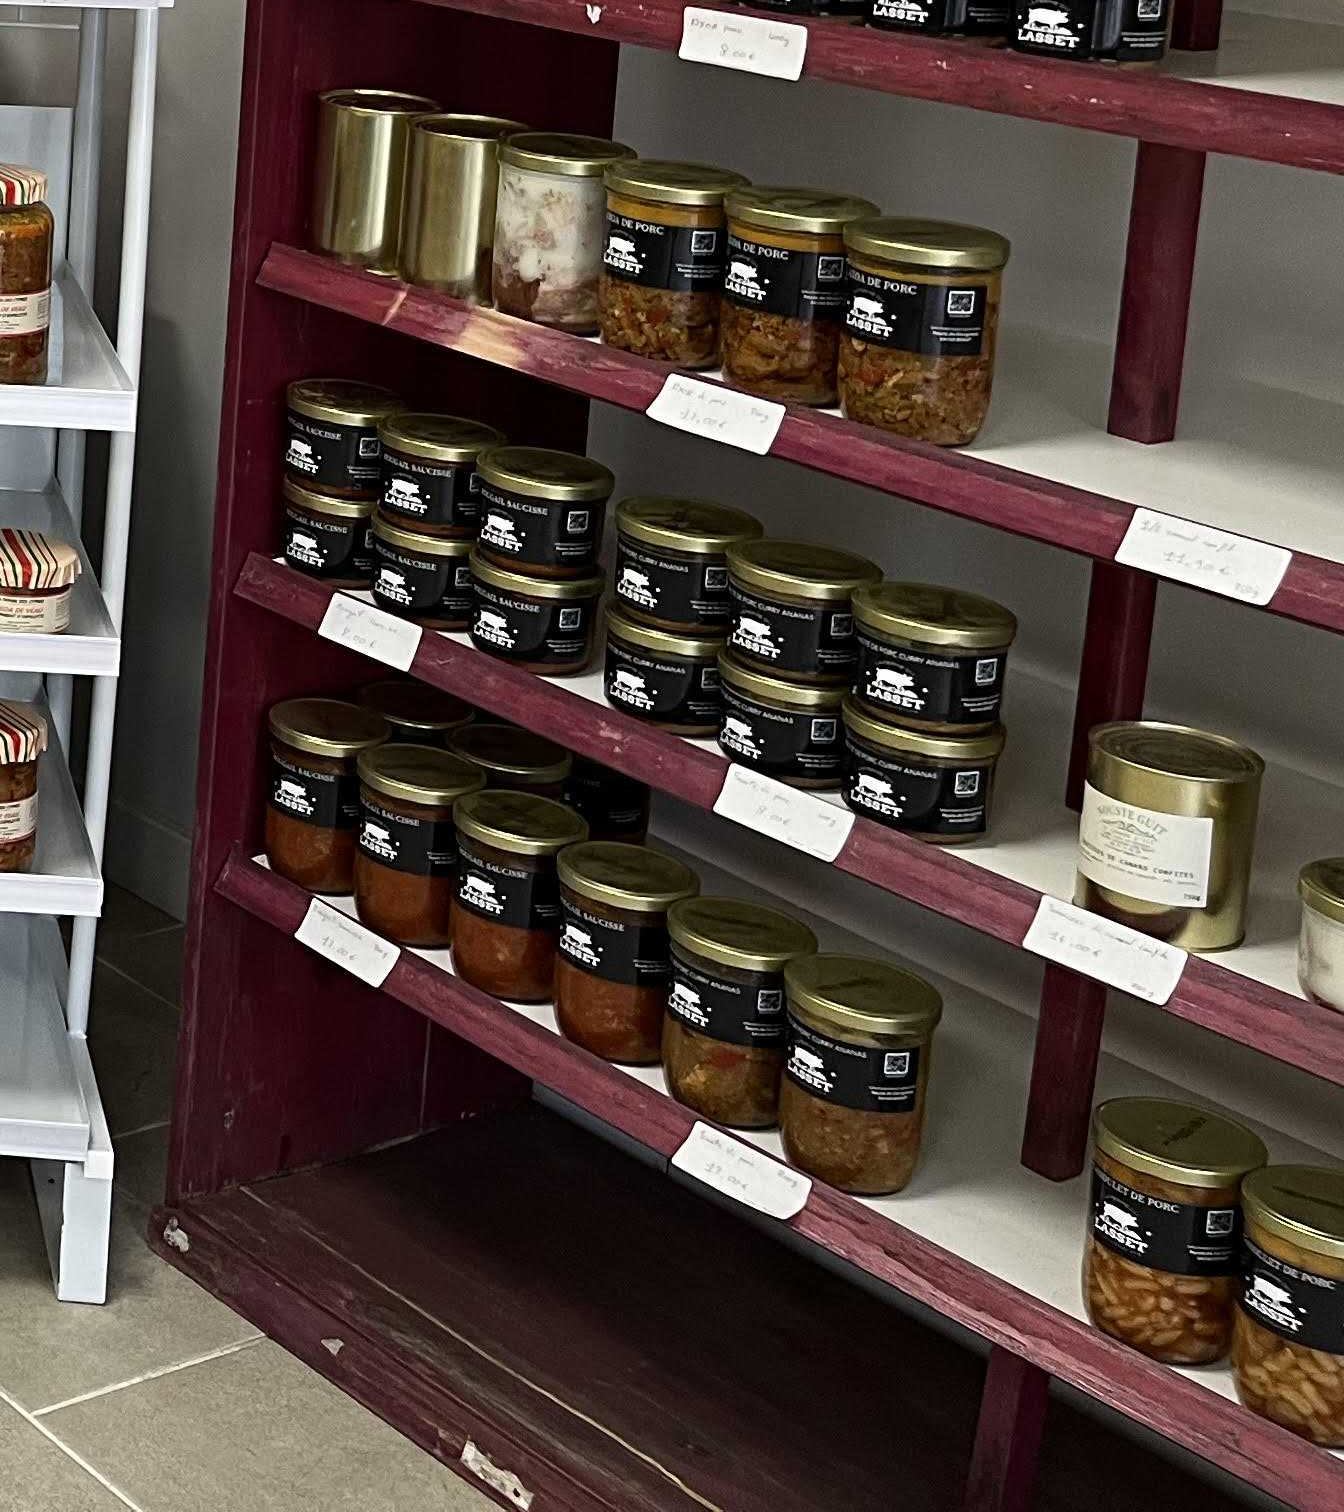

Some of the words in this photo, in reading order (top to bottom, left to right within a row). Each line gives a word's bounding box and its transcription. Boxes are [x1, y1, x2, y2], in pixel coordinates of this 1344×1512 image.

[873, 3, 928, 23] LASSET
[603, 254, 644, 275] LASSET
[725, 278, 767, 301] LASSET
[866, 275, 881, 289] DE
[883, 279, 917, 296] PORC
[384, 492, 428, 515] LASSET
[617, 583, 658, 608] LASSET
[474, 624, 515, 649] LASSET
[610, 685, 654, 711] LASSET
[866, 684, 925, 711] LASSET
[850, 789, 904, 818] LASSET
[460, 888, 504, 915] LASSET
[668, 998, 709, 1028] LASSET
[787, 1058, 833, 1093] LASSET
[1131, 1191, 1145, 1204] DE
[1147, 1196, 1180, 1214] PORC
[1245, 1290, 1303, 1332] LASSET
